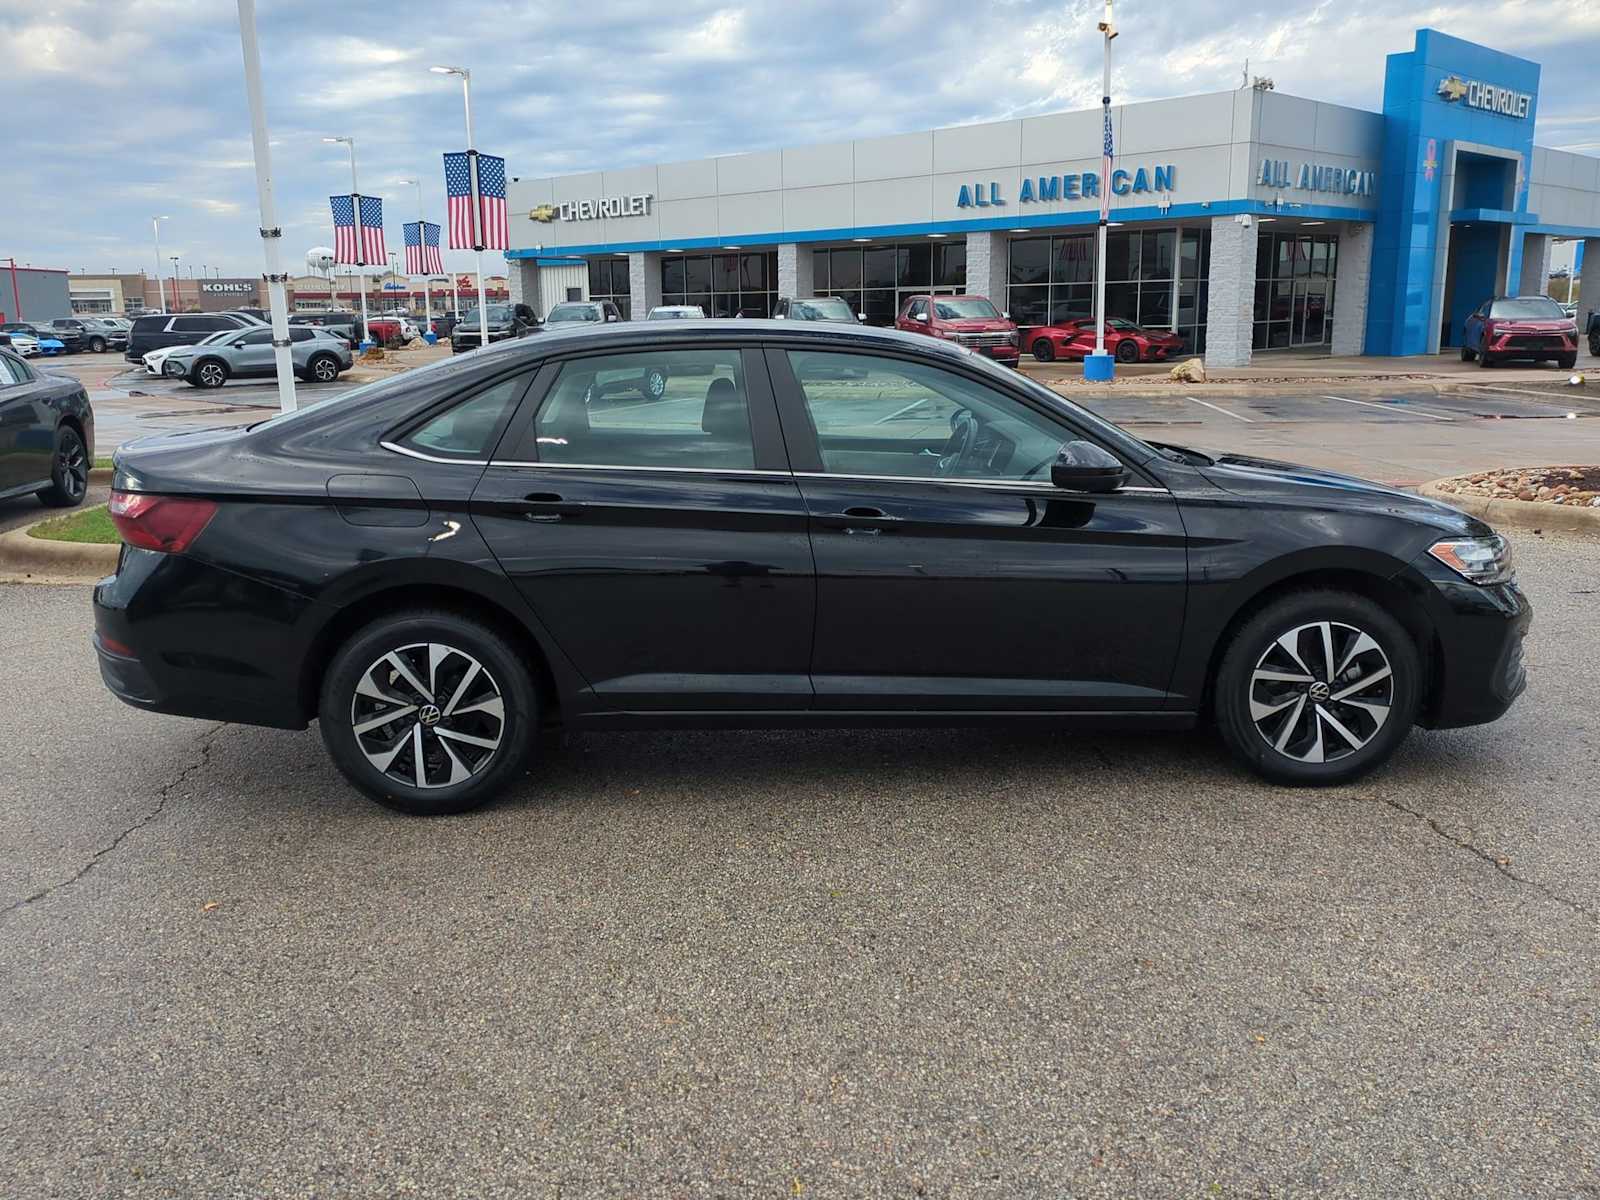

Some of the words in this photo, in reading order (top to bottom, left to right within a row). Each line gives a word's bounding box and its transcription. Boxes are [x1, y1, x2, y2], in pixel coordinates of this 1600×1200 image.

[1469, 80, 1532, 119] CHEVROLET
[957, 182, 1004, 207] ALL
[1019, 165, 1174, 203] AMERCAN
[1257, 159, 1291, 188] ALL
[1296, 163, 1377, 196] AMERICAN
[559, 194, 652, 221] CHEVROLET
[202, 283, 252, 292] KOHL'S
